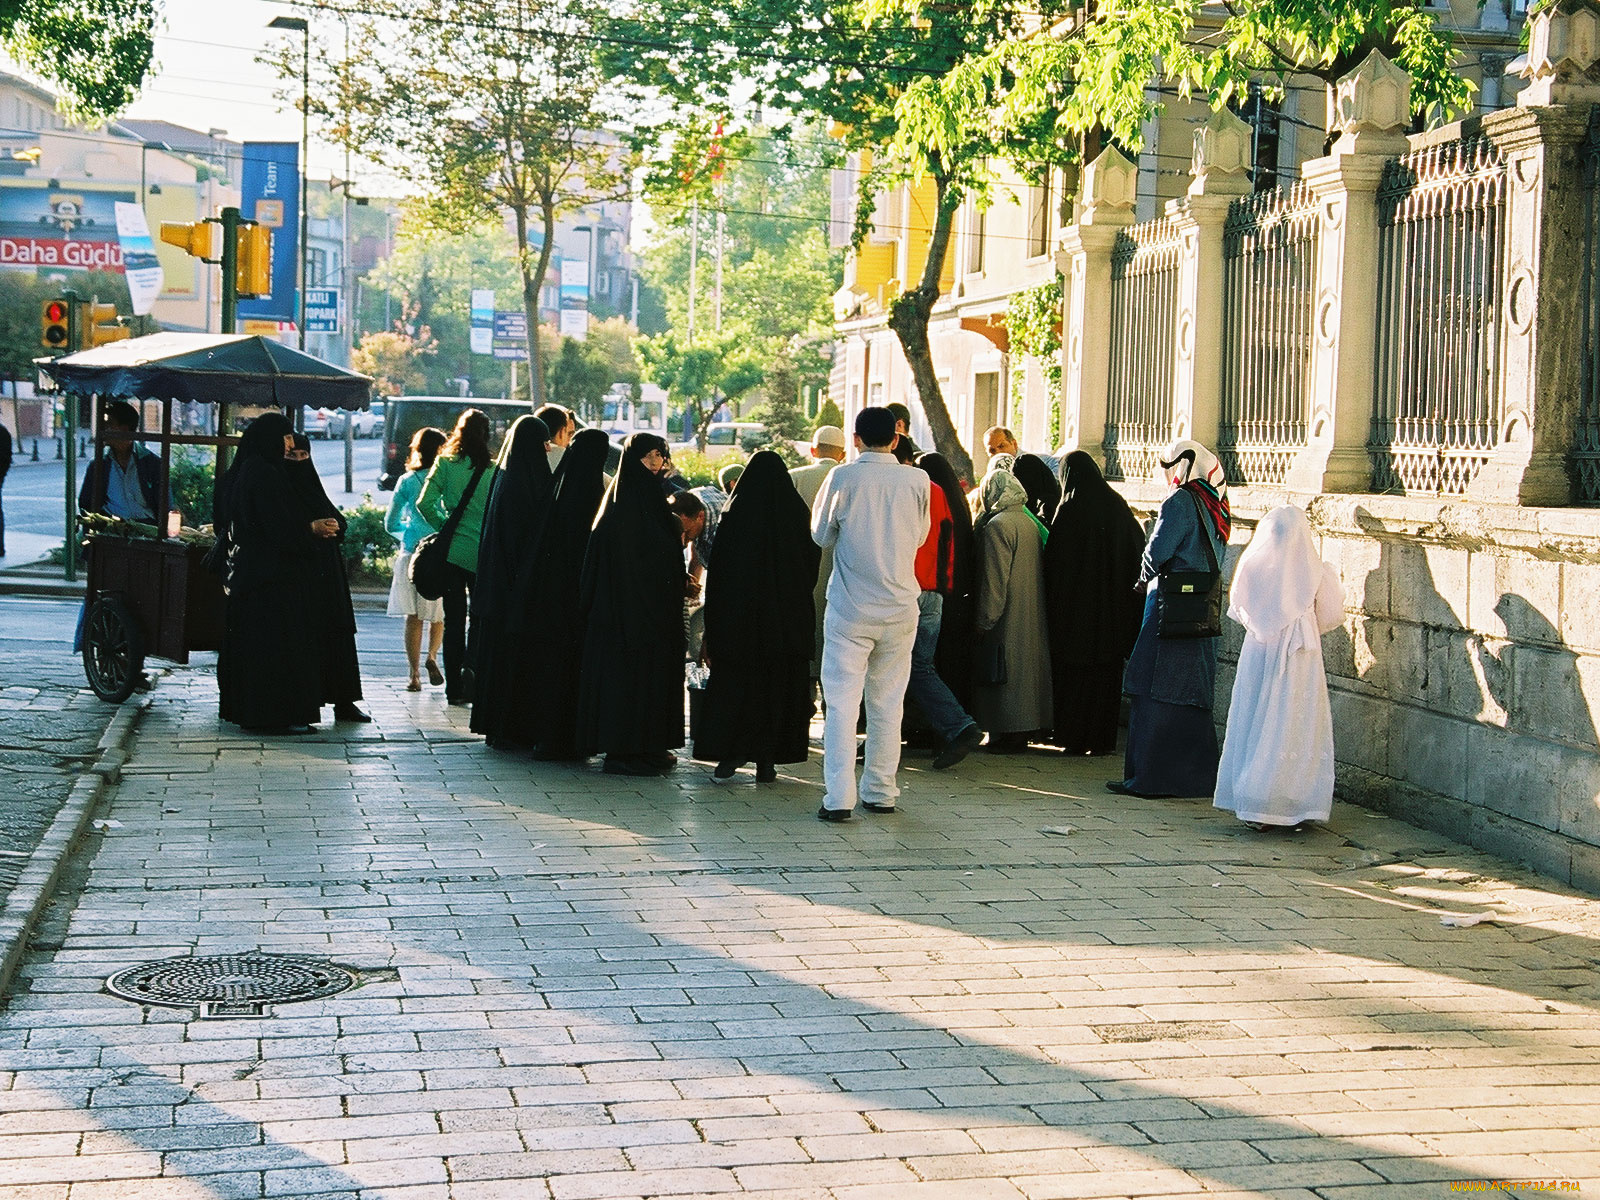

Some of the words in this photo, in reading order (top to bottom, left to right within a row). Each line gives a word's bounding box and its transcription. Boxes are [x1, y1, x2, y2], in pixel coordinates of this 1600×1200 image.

[264, 161, 278, 198] Team
[0, 240, 58, 263] Daha
[63, 242, 124, 269] Güçlü
[305, 307, 336, 319] TOPARK
